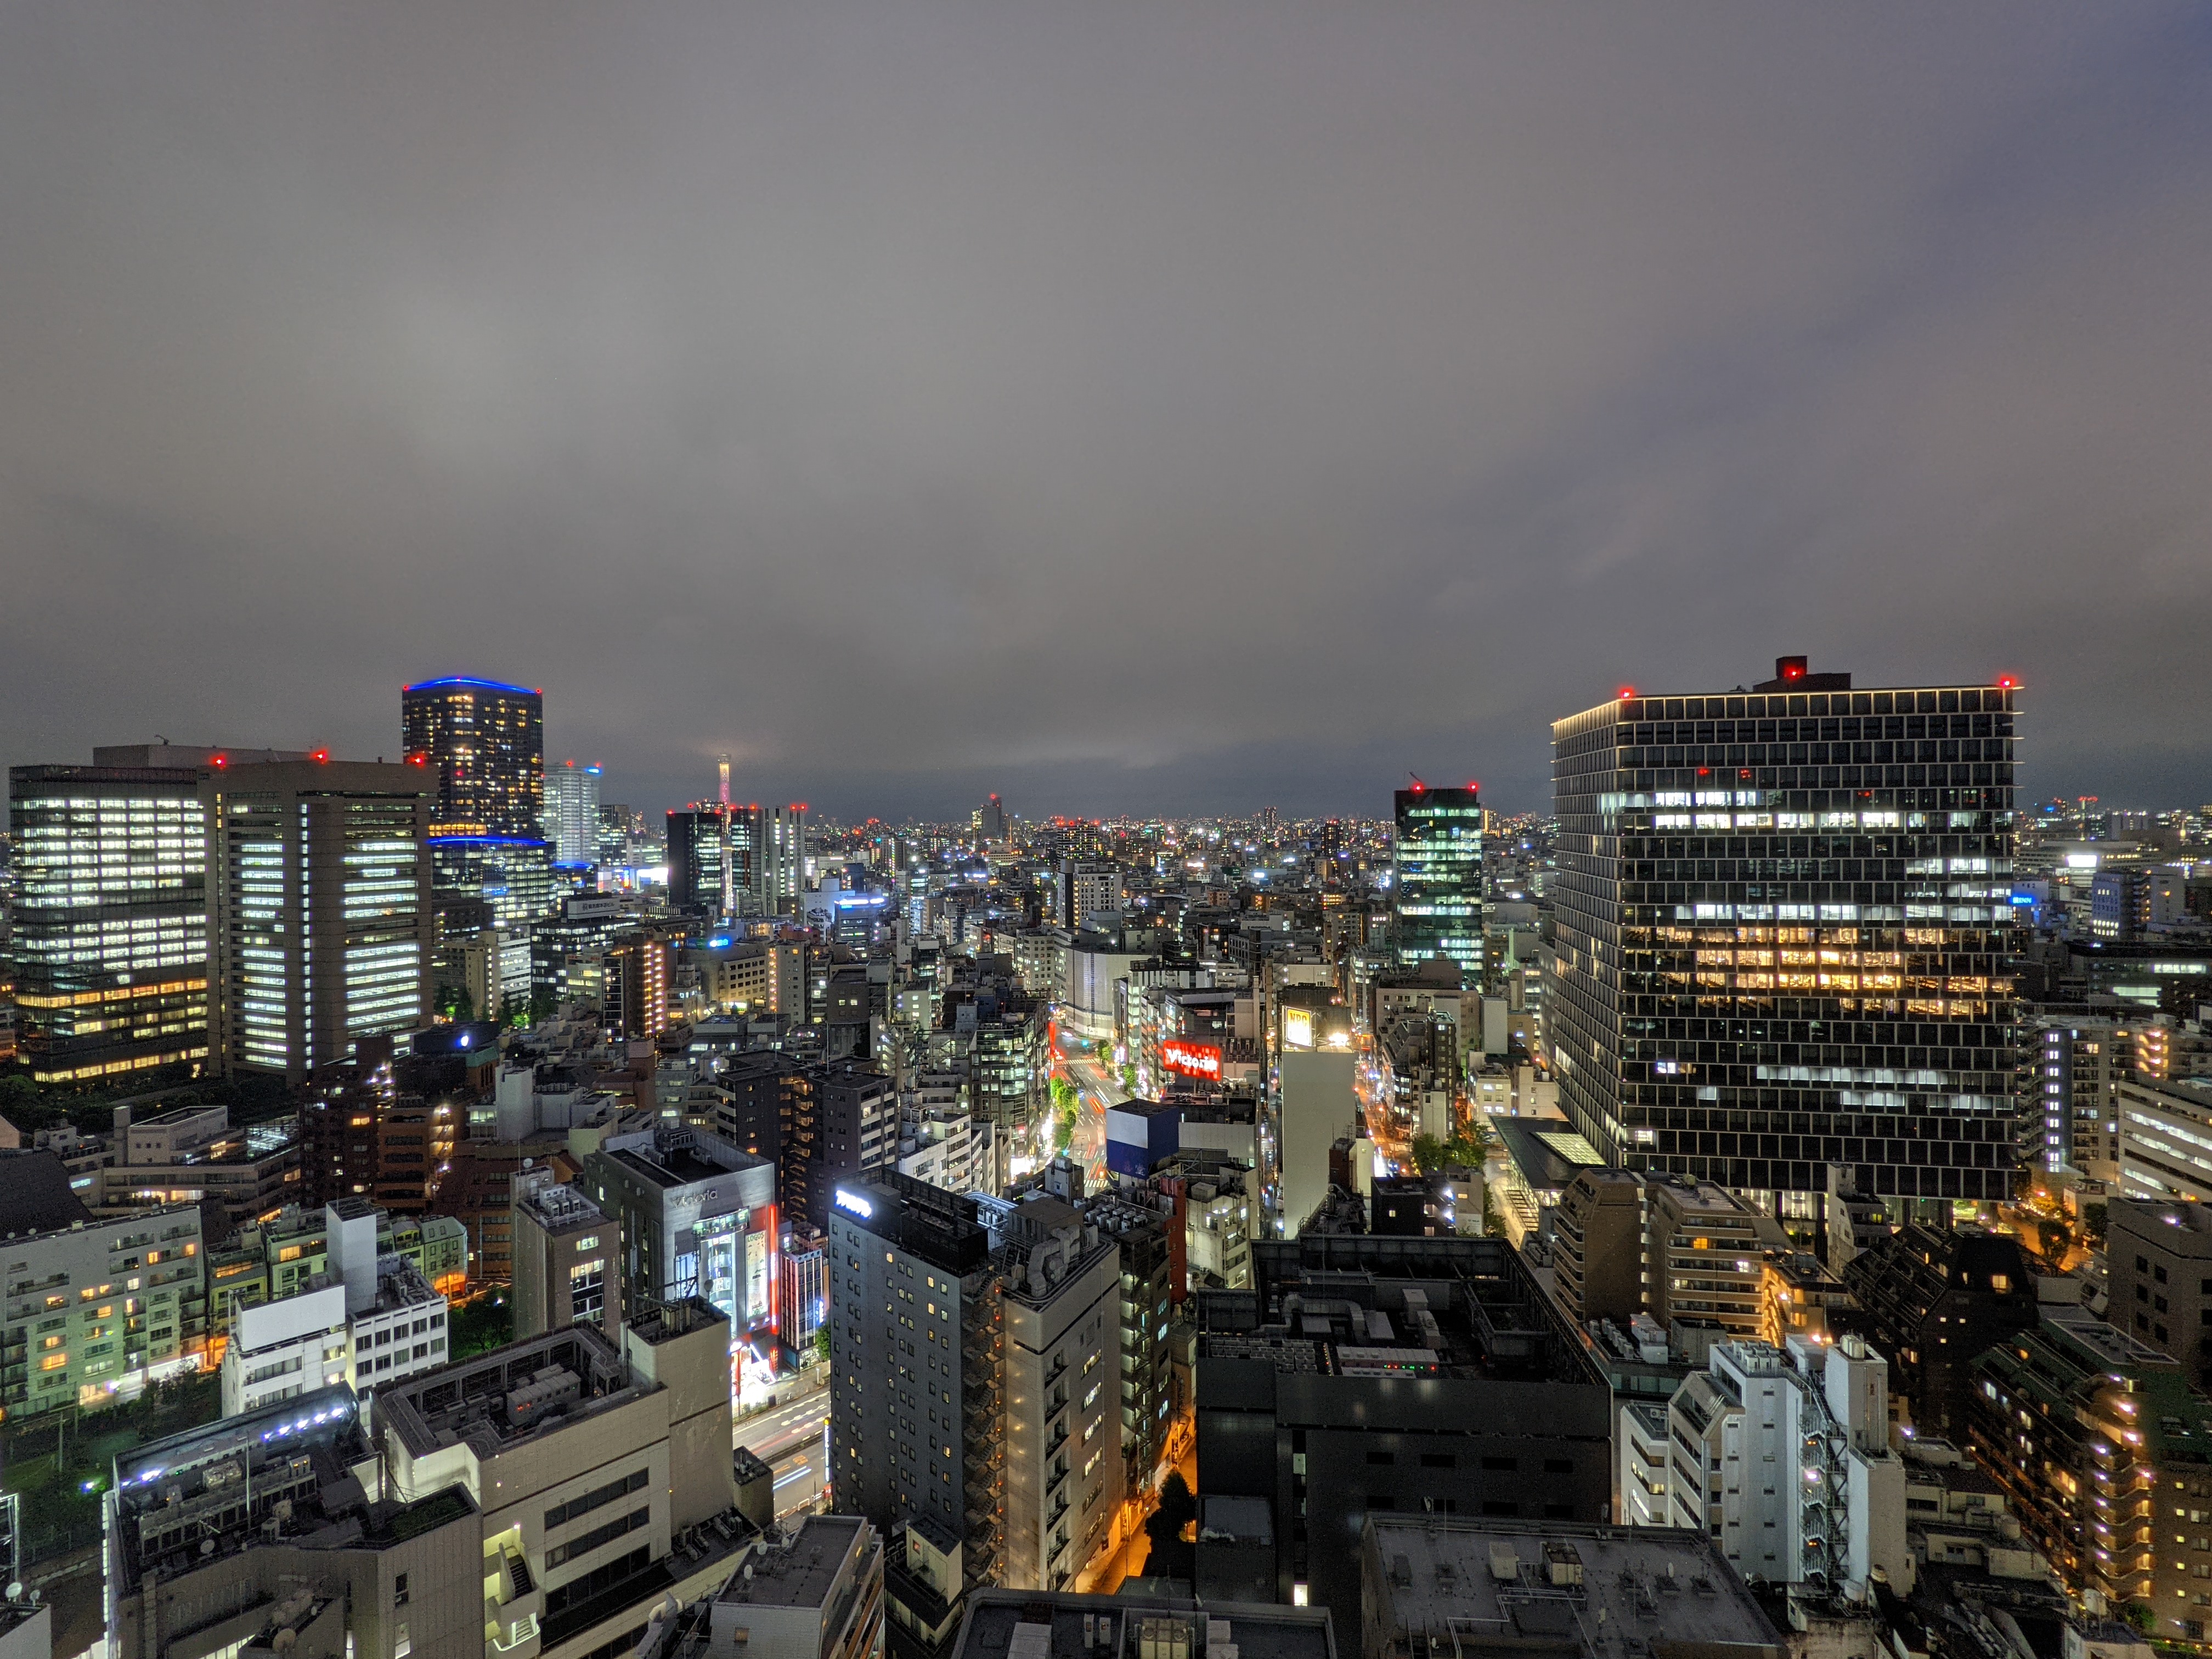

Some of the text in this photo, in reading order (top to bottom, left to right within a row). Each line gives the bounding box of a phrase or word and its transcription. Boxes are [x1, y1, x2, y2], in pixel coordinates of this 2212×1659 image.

[1166, 1048, 1217, 1071] Victoria
[671, 1189, 718, 1209] Victoria
[747, 1232, 765, 1242] LOGOS
